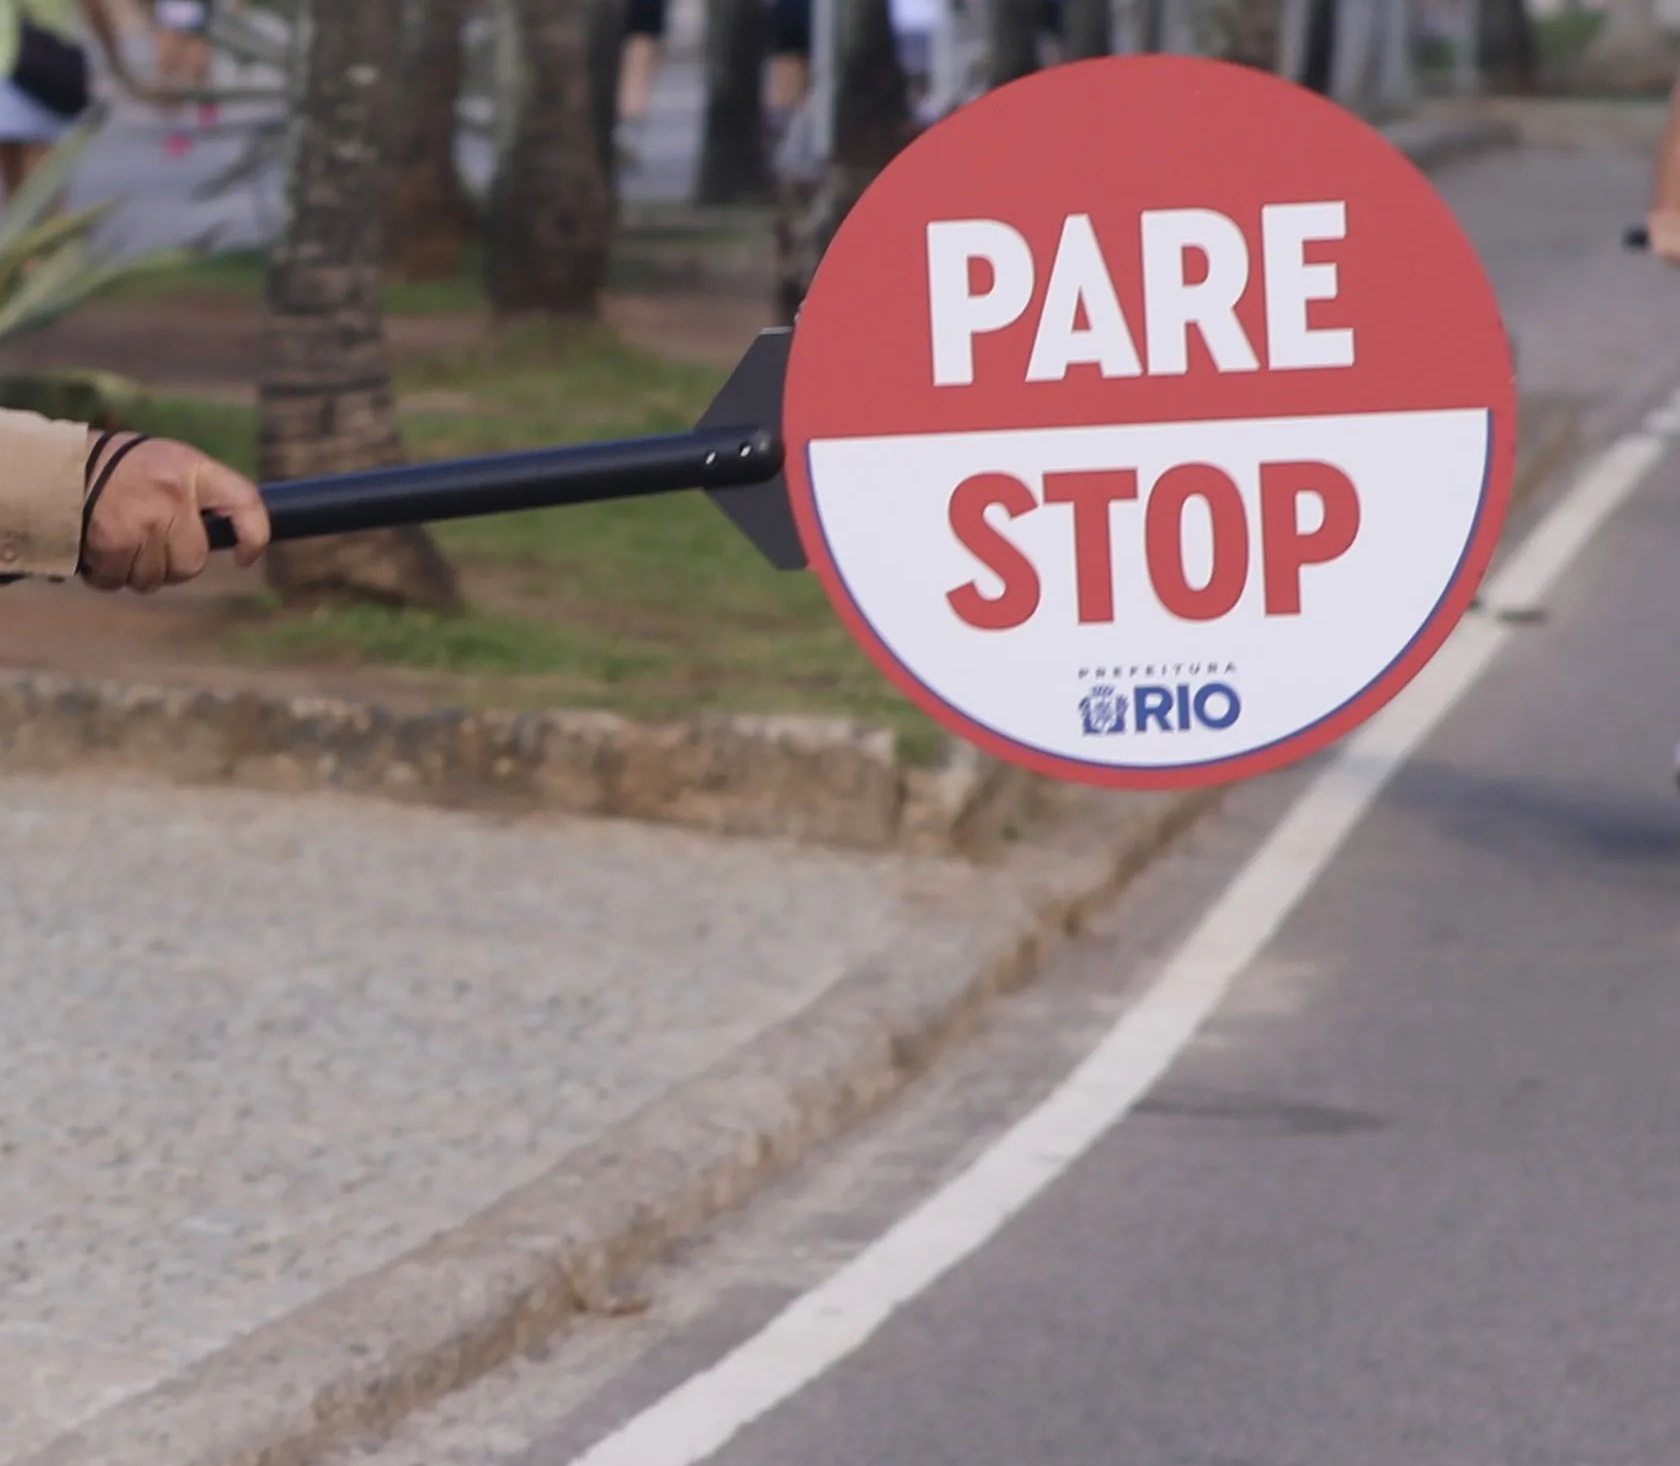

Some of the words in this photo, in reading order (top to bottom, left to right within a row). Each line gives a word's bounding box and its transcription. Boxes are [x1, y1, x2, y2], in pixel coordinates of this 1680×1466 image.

[926, 200, 1356, 387] PARE
[944, 458, 1362, 632] STOP
[1077, 660, 1239, 680] PREFEITURA
[1133, 680, 1242, 734] RIO
